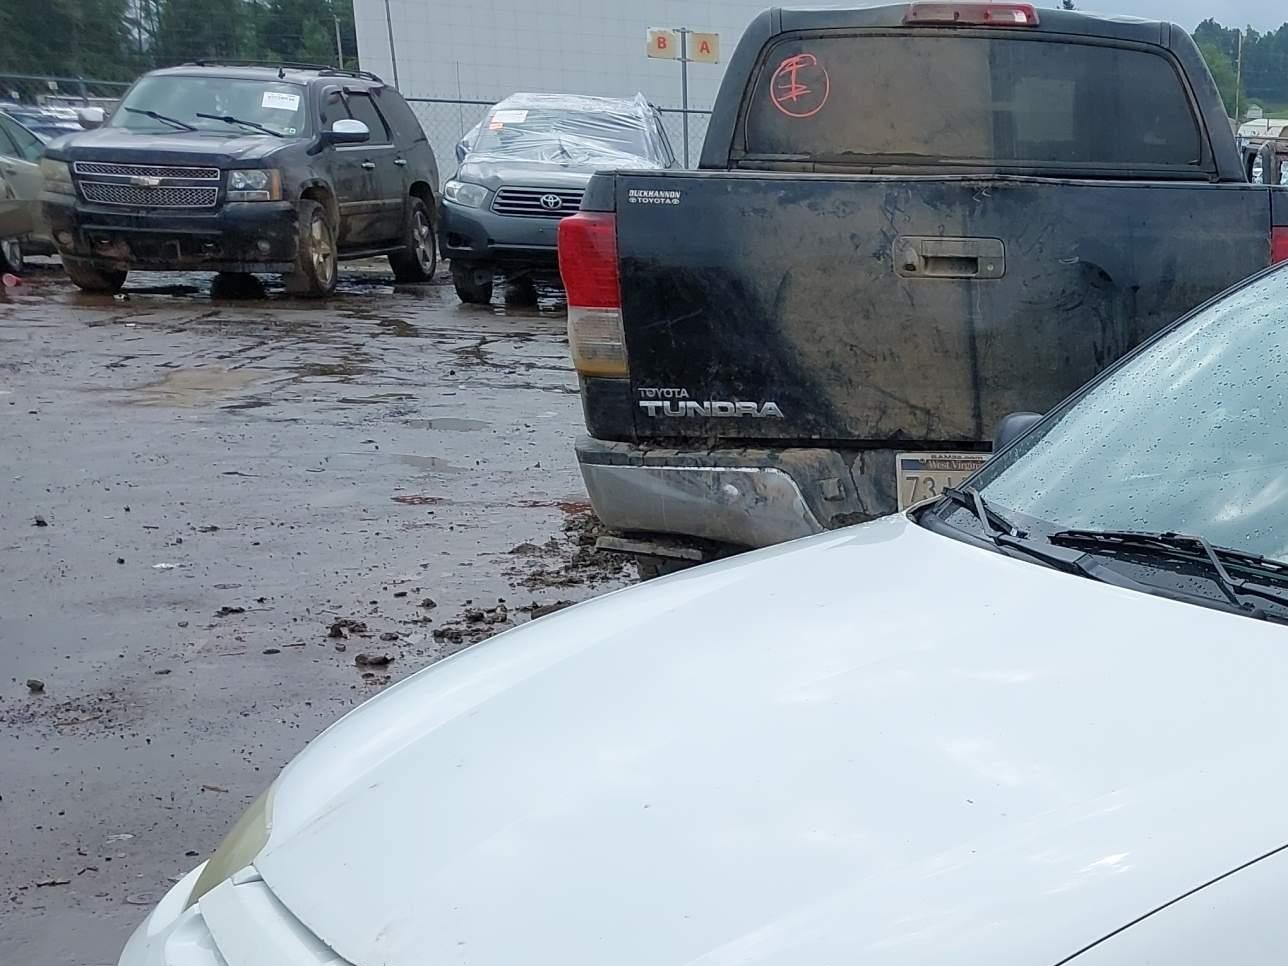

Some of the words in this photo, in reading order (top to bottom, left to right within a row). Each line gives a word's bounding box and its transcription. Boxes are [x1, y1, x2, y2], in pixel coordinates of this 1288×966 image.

[657, 36, 667, 49] B
[700, 41, 710, 54] A
[637, 387, 690, 398] TOYOTA
[639, 400, 785, 418] TUNDRA
[928, 459, 950, 469] West
